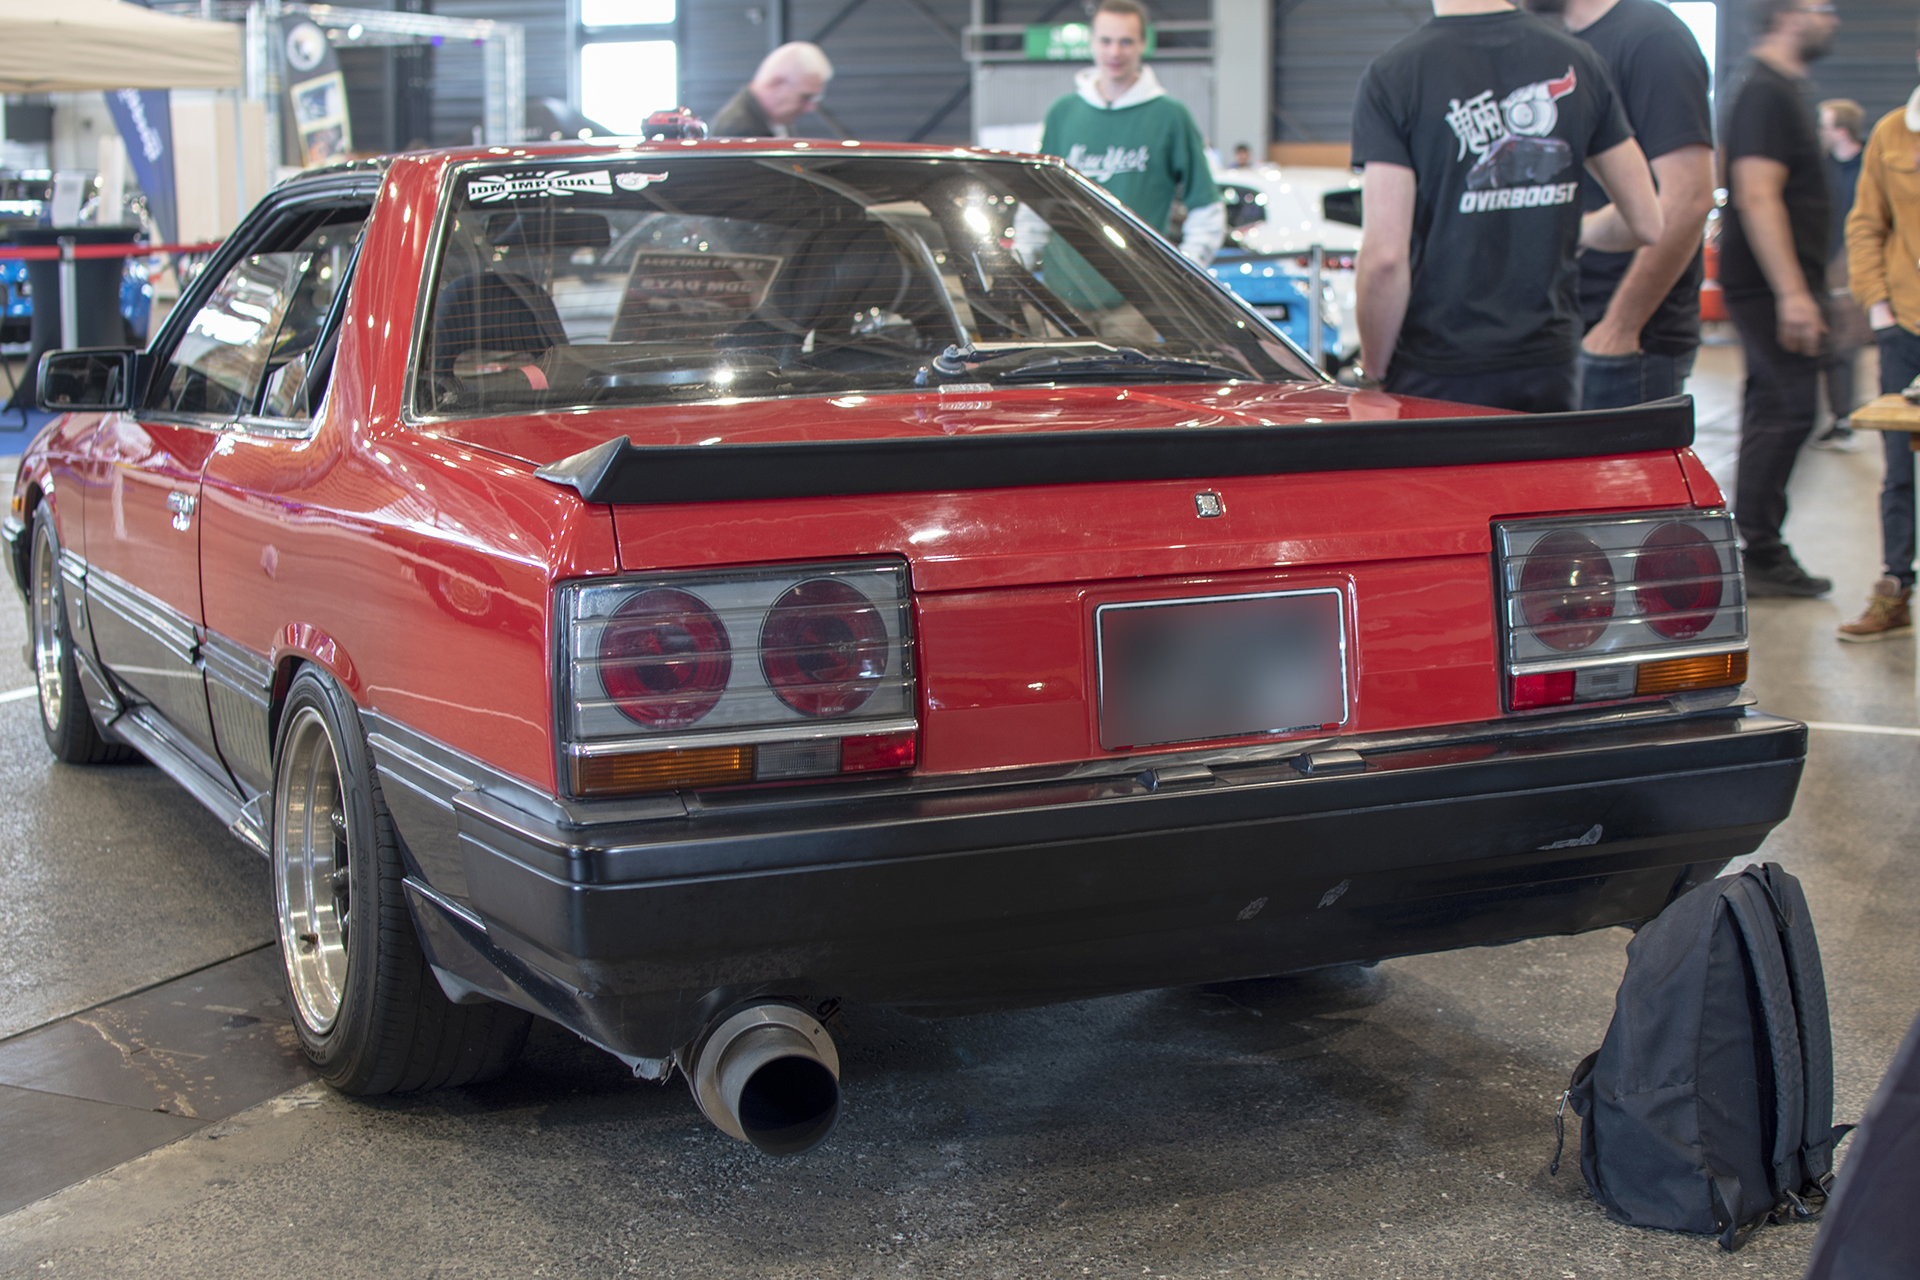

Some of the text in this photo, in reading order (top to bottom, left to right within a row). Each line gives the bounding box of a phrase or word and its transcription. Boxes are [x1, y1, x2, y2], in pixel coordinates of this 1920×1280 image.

[1097, 145, 1149, 182] York
[470, 183, 505, 195] JDM
[1459, 181, 1579, 213] OVERBOOST
